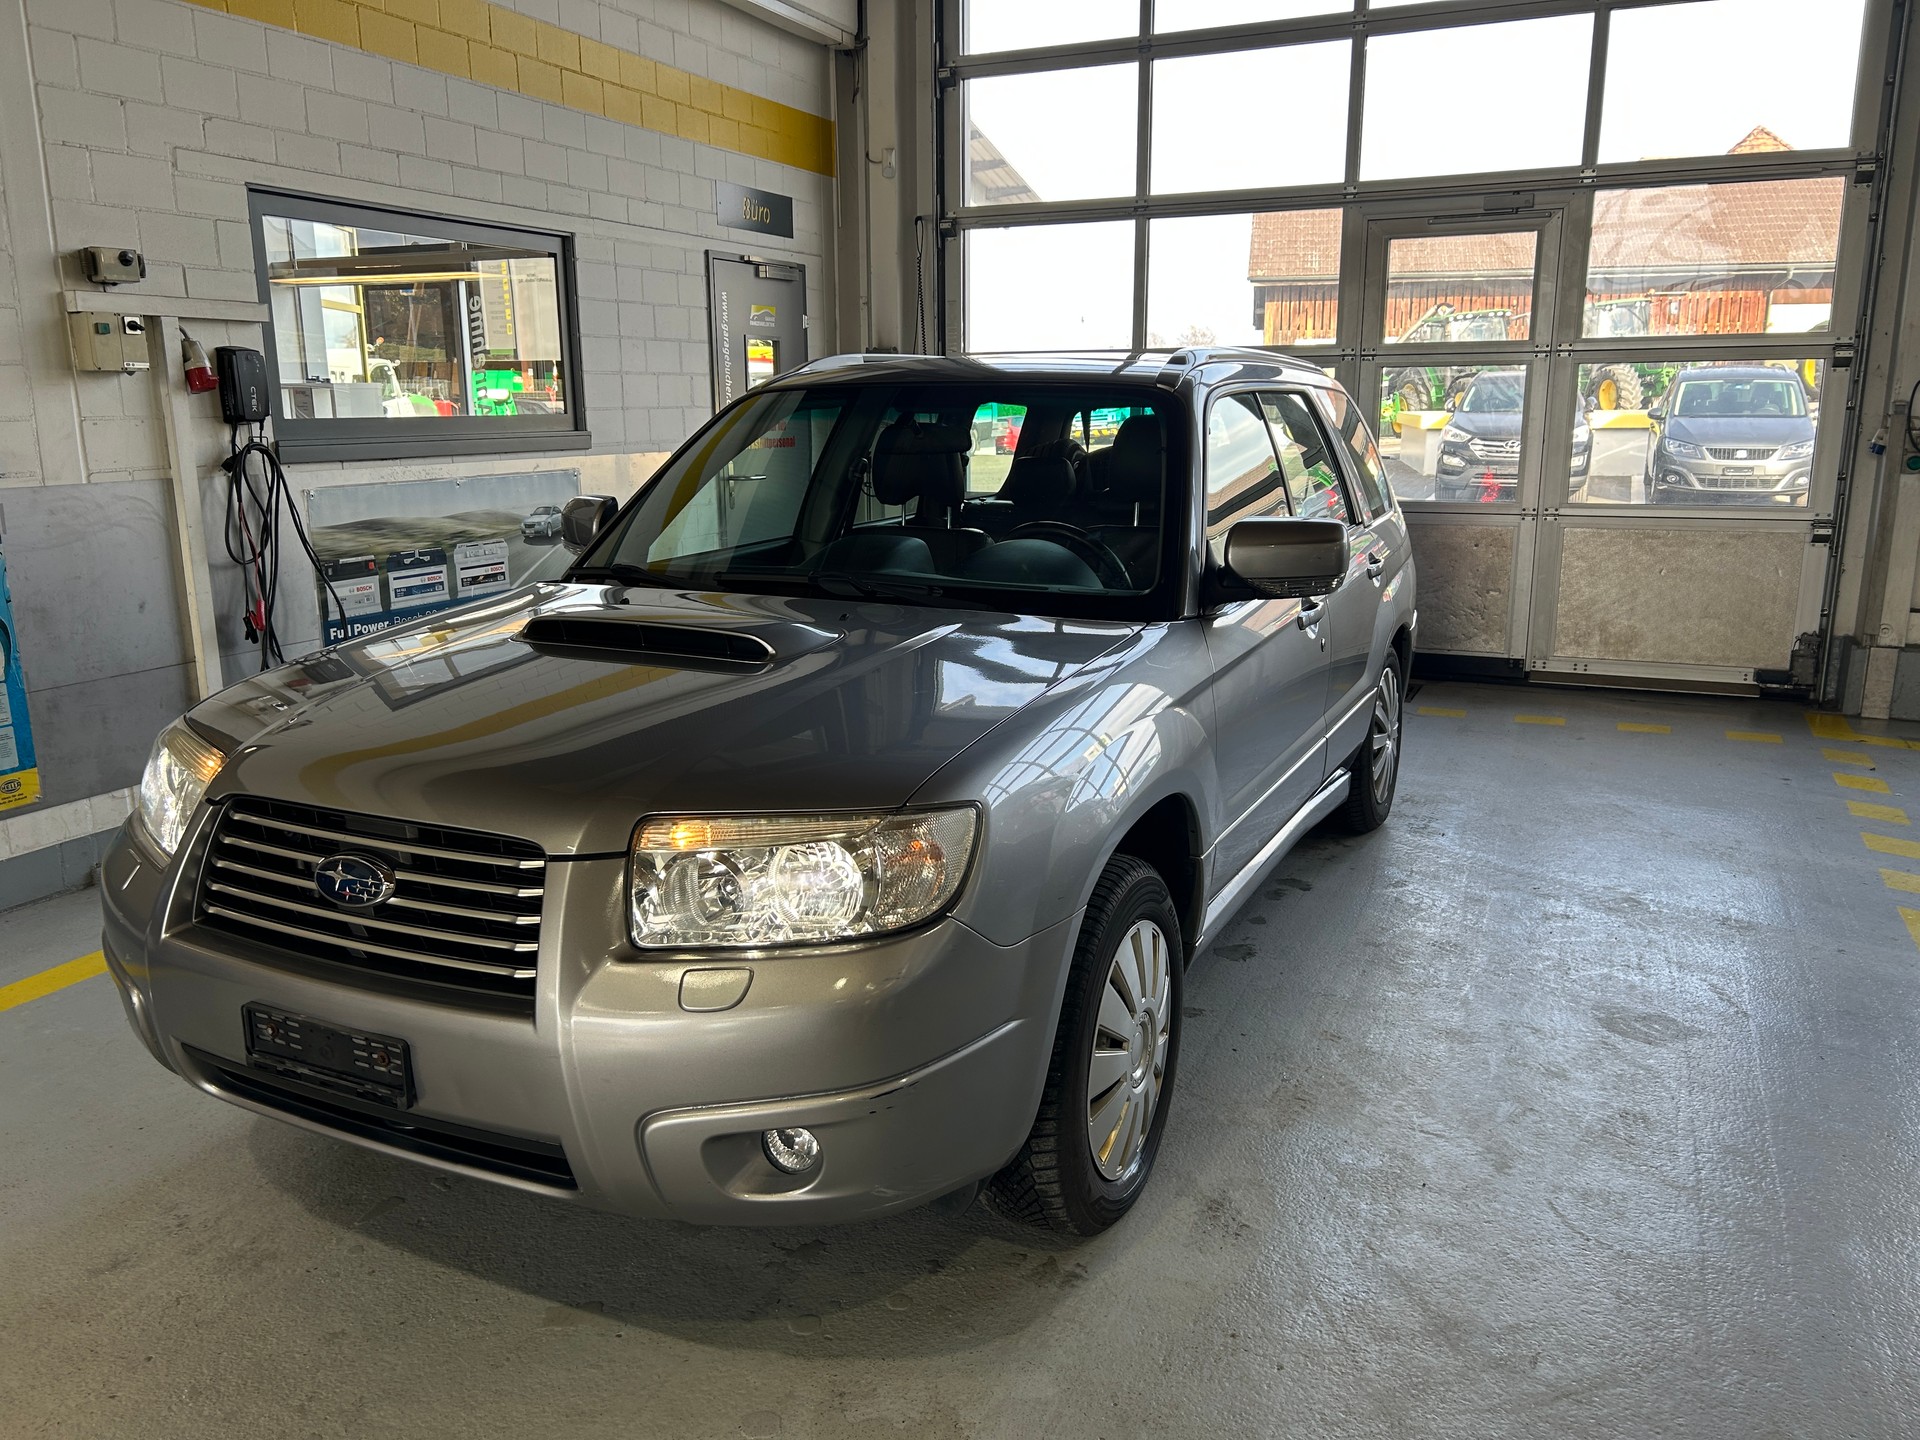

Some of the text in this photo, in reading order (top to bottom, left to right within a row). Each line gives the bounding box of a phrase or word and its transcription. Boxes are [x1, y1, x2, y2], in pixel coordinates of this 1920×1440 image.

[743, 197, 771, 224] Büro
[250, 386, 258, 412] CTEK
[329, 624, 352, 640] Ful
